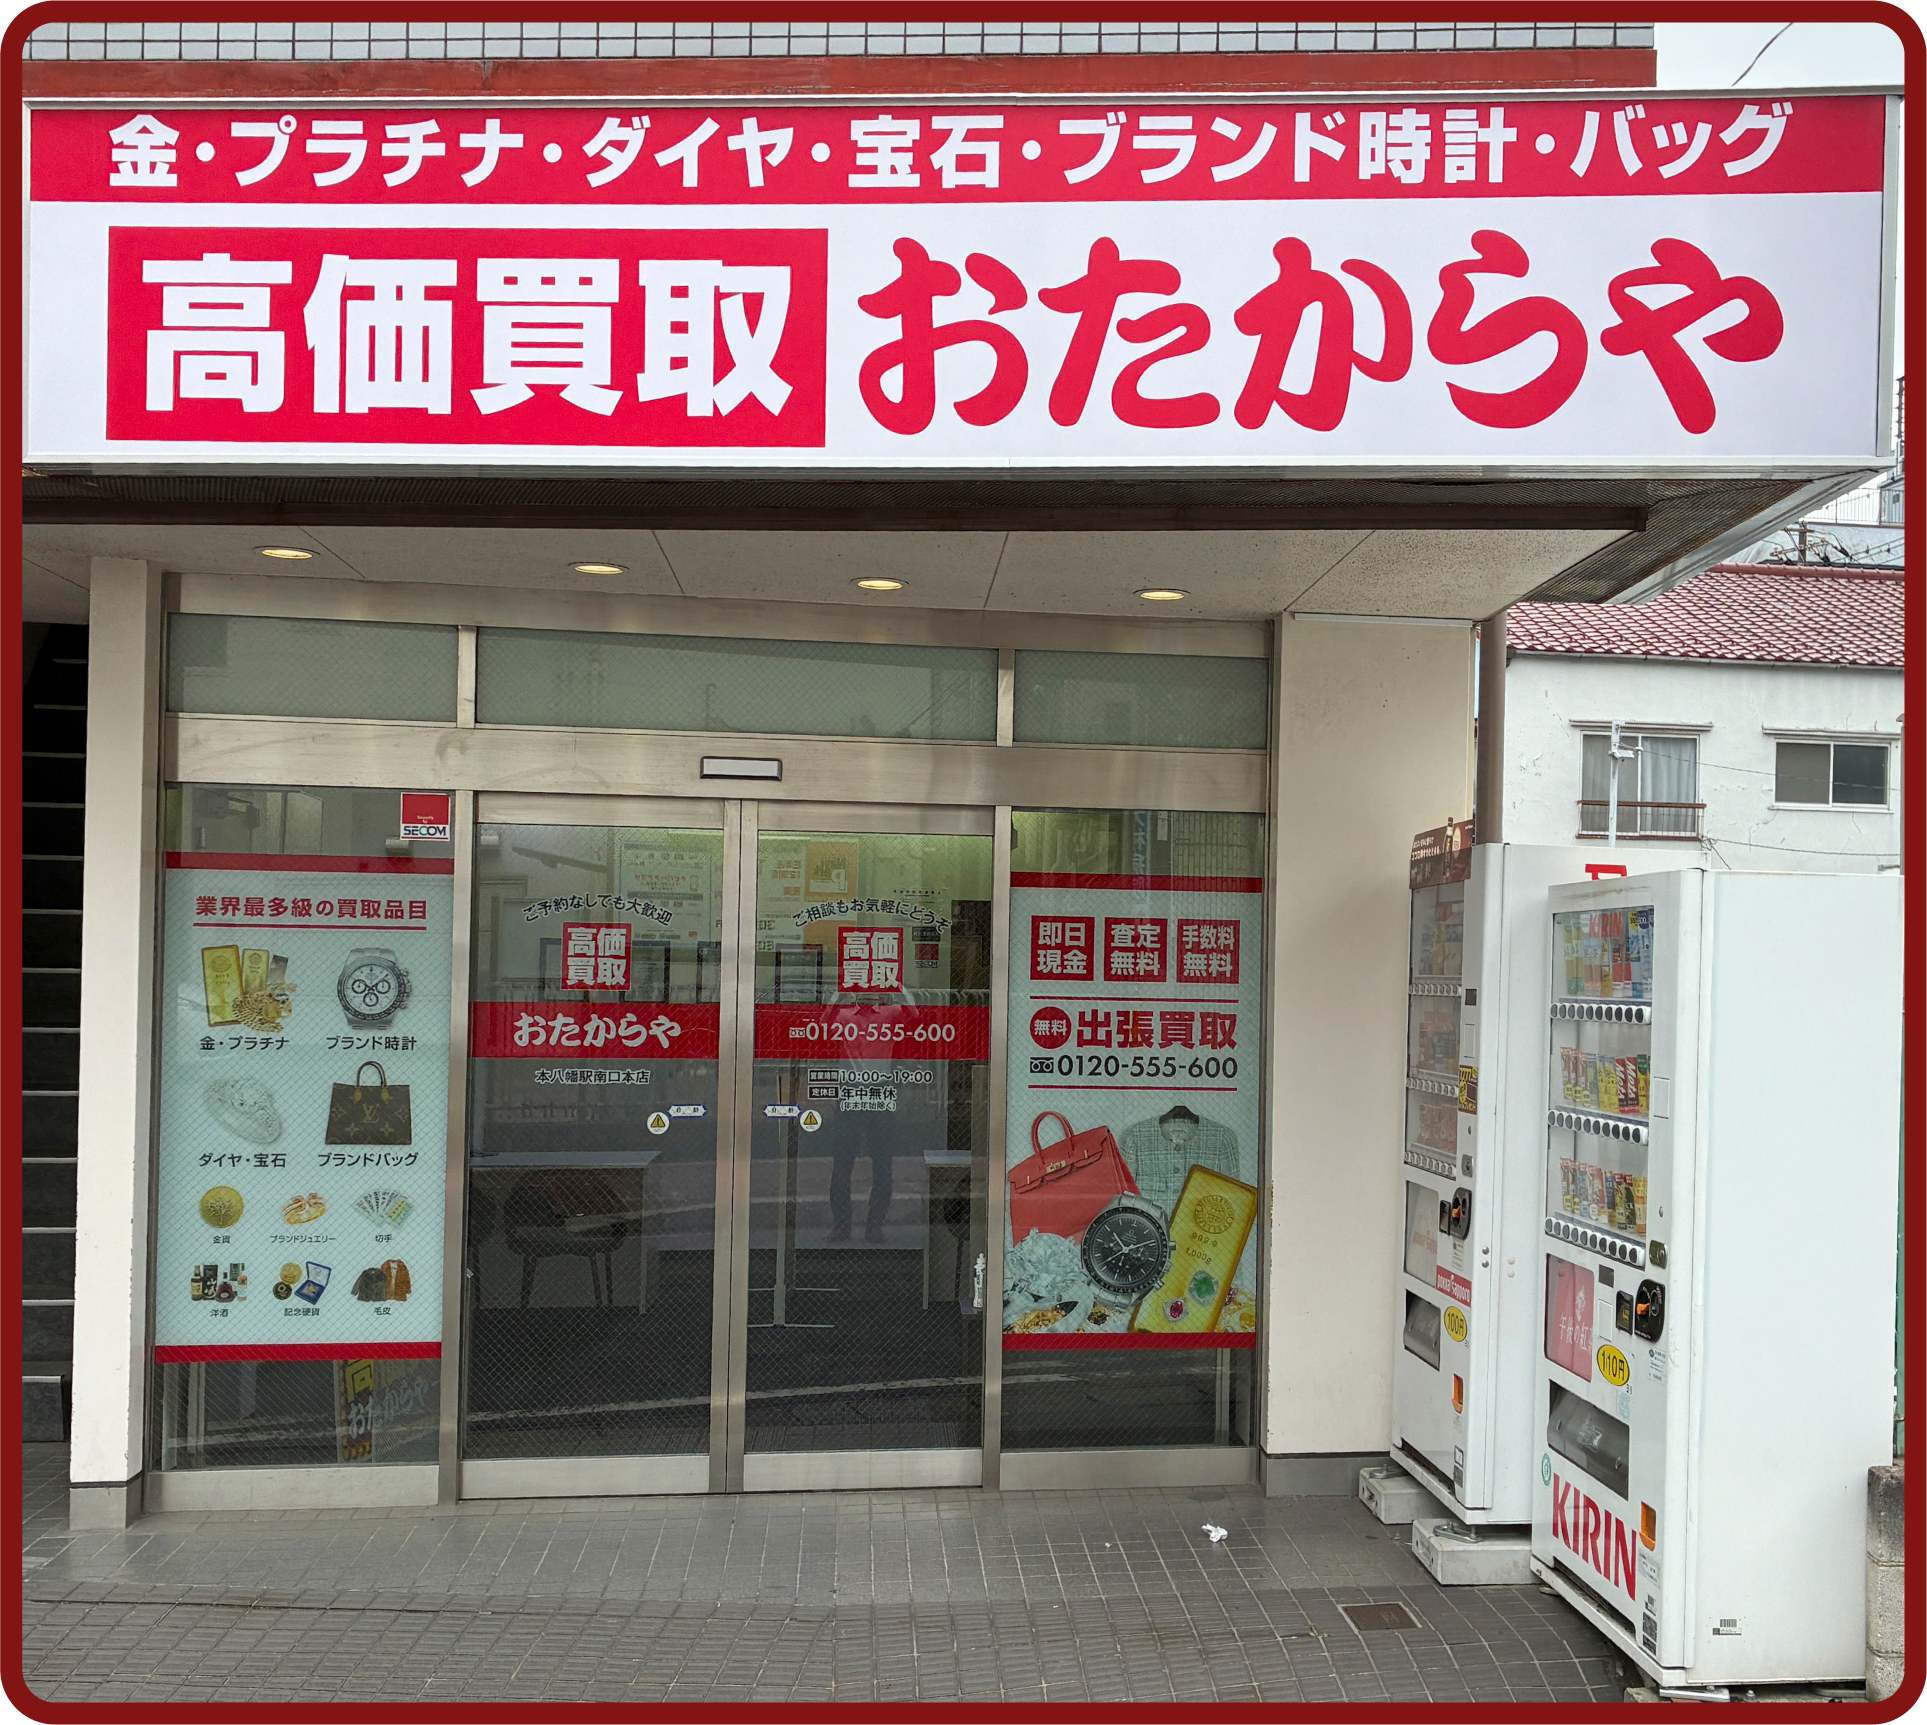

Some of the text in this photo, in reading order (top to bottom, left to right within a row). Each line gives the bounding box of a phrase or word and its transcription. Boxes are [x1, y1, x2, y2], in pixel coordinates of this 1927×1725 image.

[142, 229, 1784, 435] 高価買取 おたからや
[404, 826, 446, 836] SECOM
[196, 895, 427, 920] 業界最多級の買取品目
[522, 894, 673, 926] ご予約なしでも大歓迎
[792, 898, 952, 932] ご相談もお気軽にどうぞ
[567, 927, 627, 957] 高価
[843, 931, 899, 960] 高価
[1038, 922, 1086, 947] 即日
[1111, 924, 1161, 948] 査定
[1182, 925, 1235, 950] 手数料
[567, 958, 627, 986] 買取
[1037, 950, 1087, 975] 現金
[1110, 951, 1160, 976] 無料
[1184, 952, 1233, 977] 無料
[843, 962, 899, 989] 買取
[513, 1012, 681, 1048] おたからや
[806, 1023, 955, 1042] 0120-555-600
[1034, 1009, 1237, 1050] 無料 出張買取
[200, 1036, 290, 1050] 金・プラチナ
[326, 1036, 417, 1051] ブランド時計
[536, 1069, 650, 1084] 本八幡駅南口本店
[1058, 1055, 1238, 1078] 0120-555-600
[812, 1087, 896, 1100] 定休日 年中無休
[199, 1152, 287, 1168] ダイヤ・宝石
[317, 1152, 418, 1168] ブランドバッグ
[212, 1235, 231, 1244] 金貨
[270, 1235, 336, 1243] ブランドジュエリー
[375, 1234, 393, 1243] 切手
[210, 1308, 229, 1317] 洋酒
[284, 1307, 320, 1317] 記念硬貨
[373, 1306, 392, 1316] 毛皮
[1552, 1472, 1637, 1602] KIRIN
